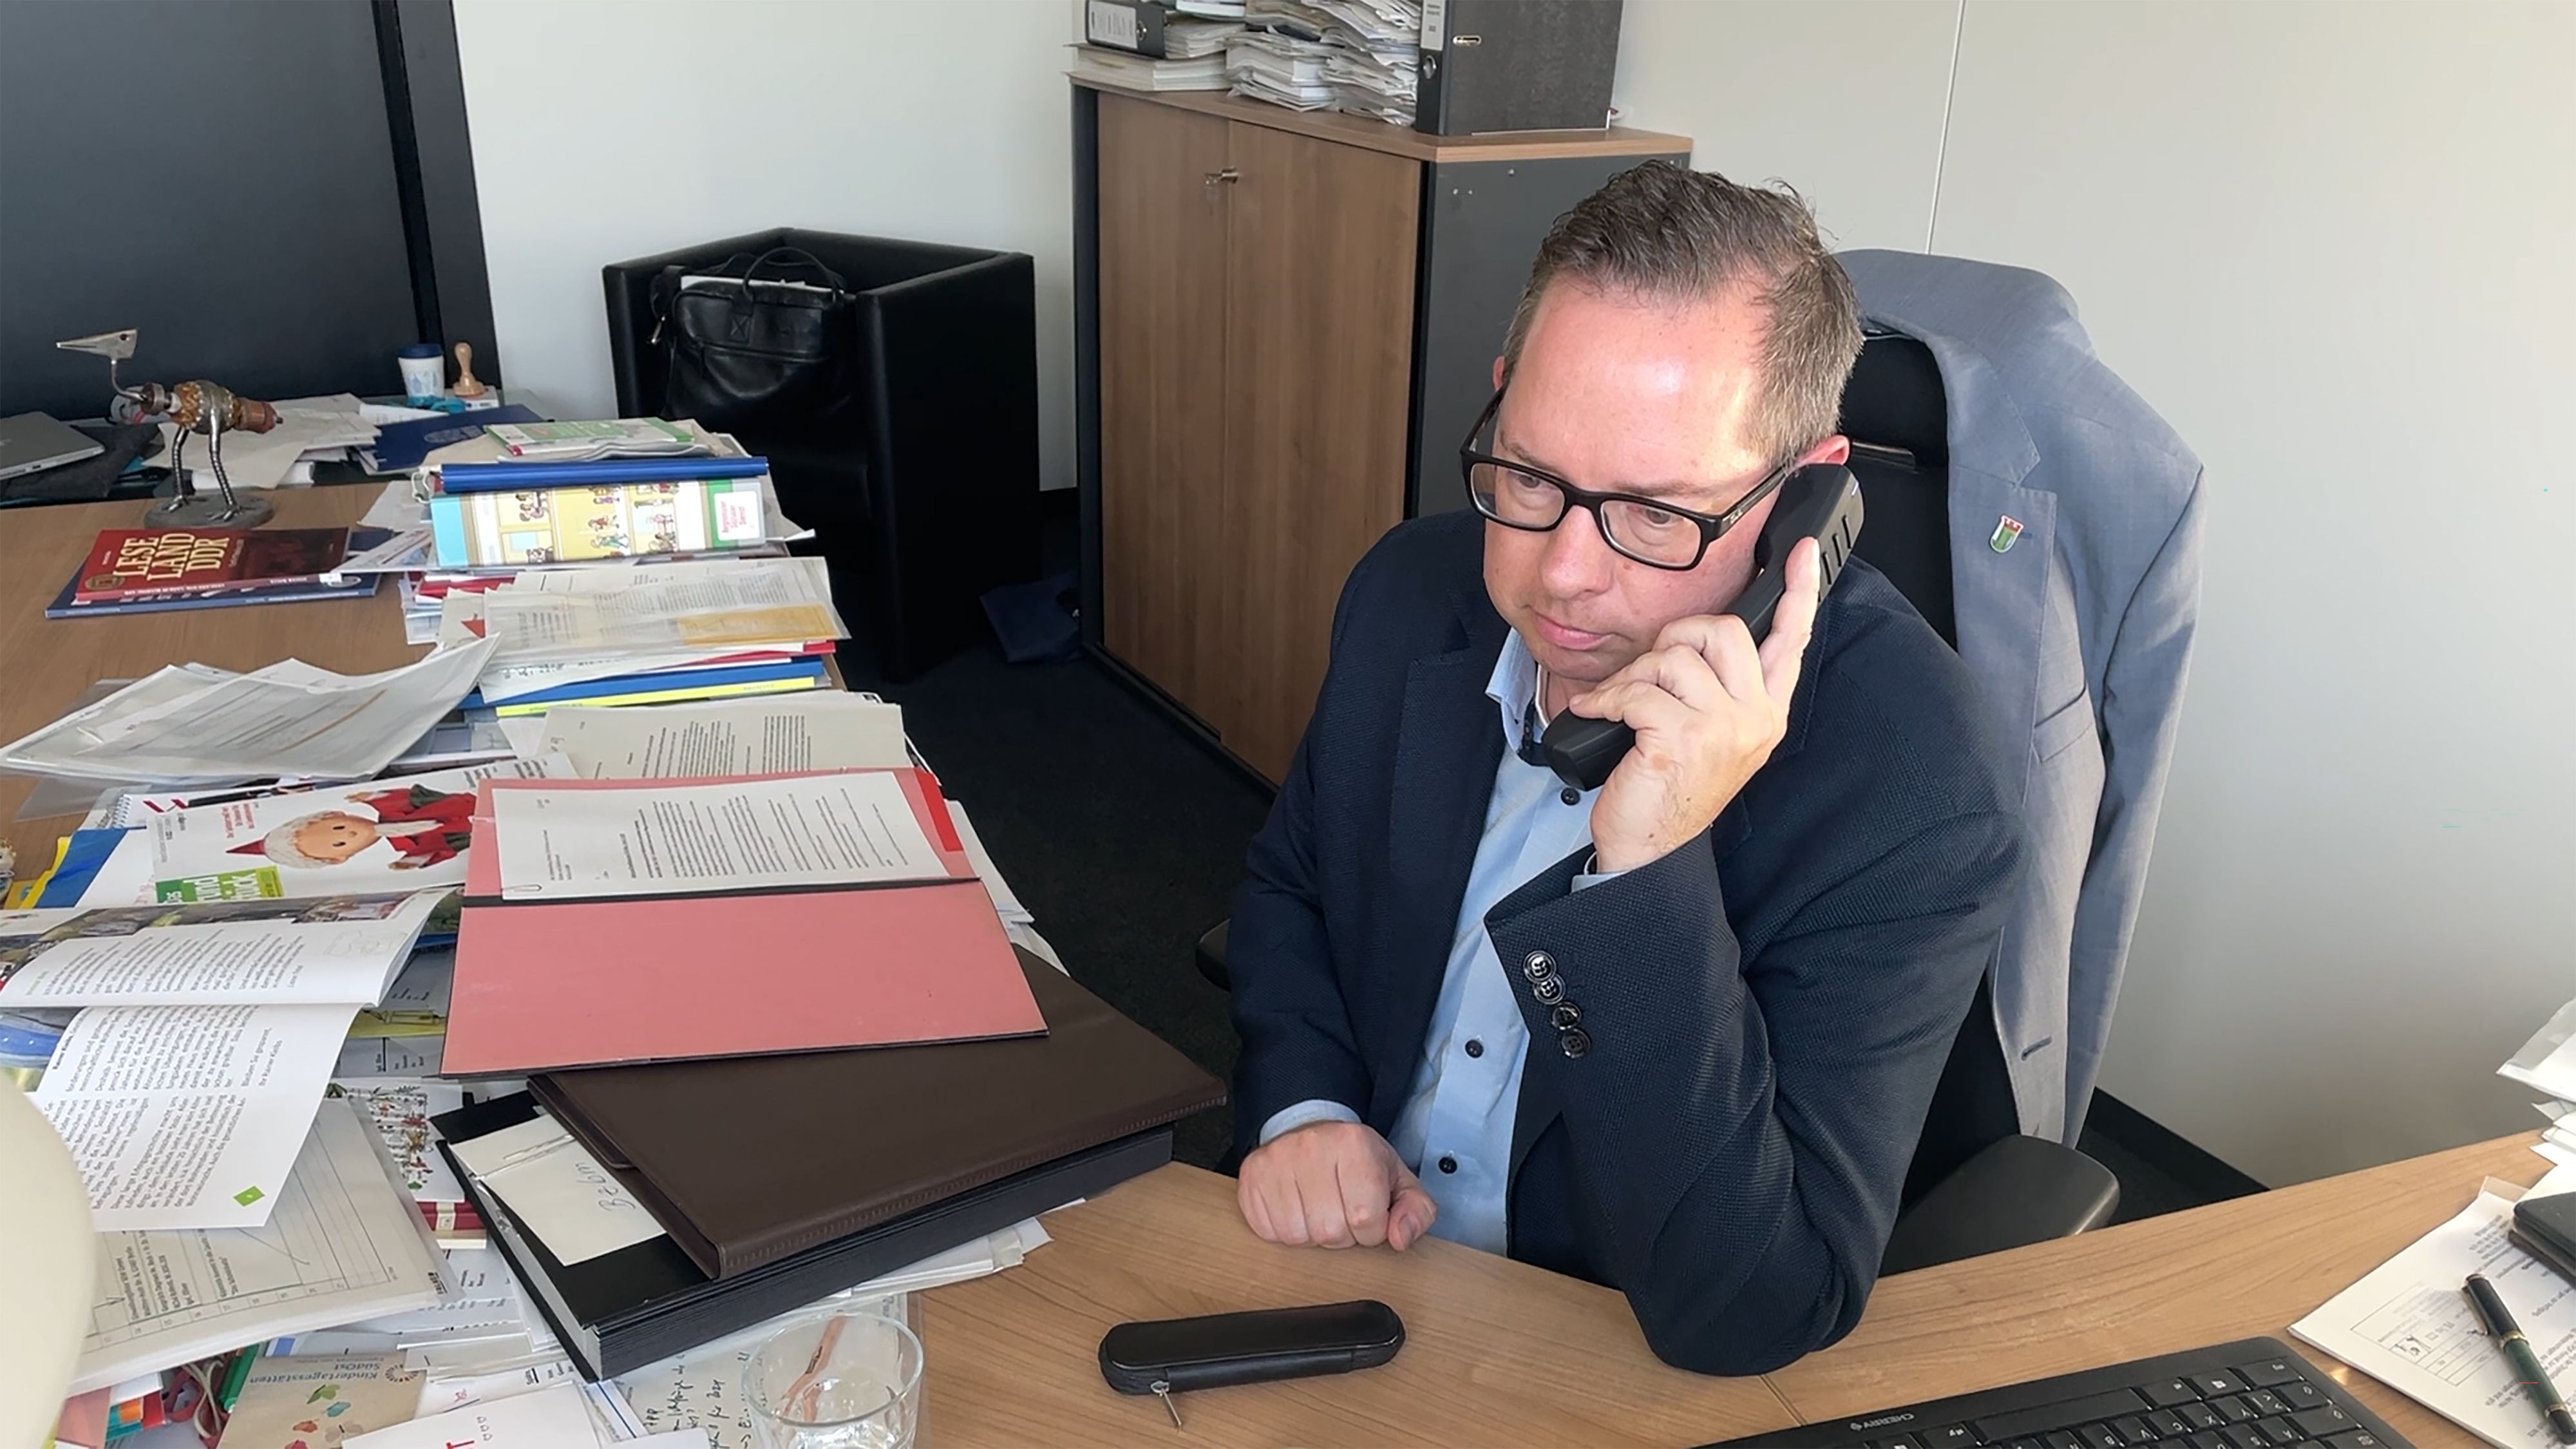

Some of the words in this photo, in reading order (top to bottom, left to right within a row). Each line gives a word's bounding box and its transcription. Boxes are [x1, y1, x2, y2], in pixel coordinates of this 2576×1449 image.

[113, 537, 160, 576] LESE
[147, 533, 195, 582] LAND
[186, 537, 229, 572] DDR
[182, 875, 221, 902] rund
[222, 872, 261, 901] tück
[249, 1372, 379, 1385] Kindertagesstätten
[334, 1363, 381, 1372] SüdOst
[1863, 1414, 1915, 1428] CHERRY
